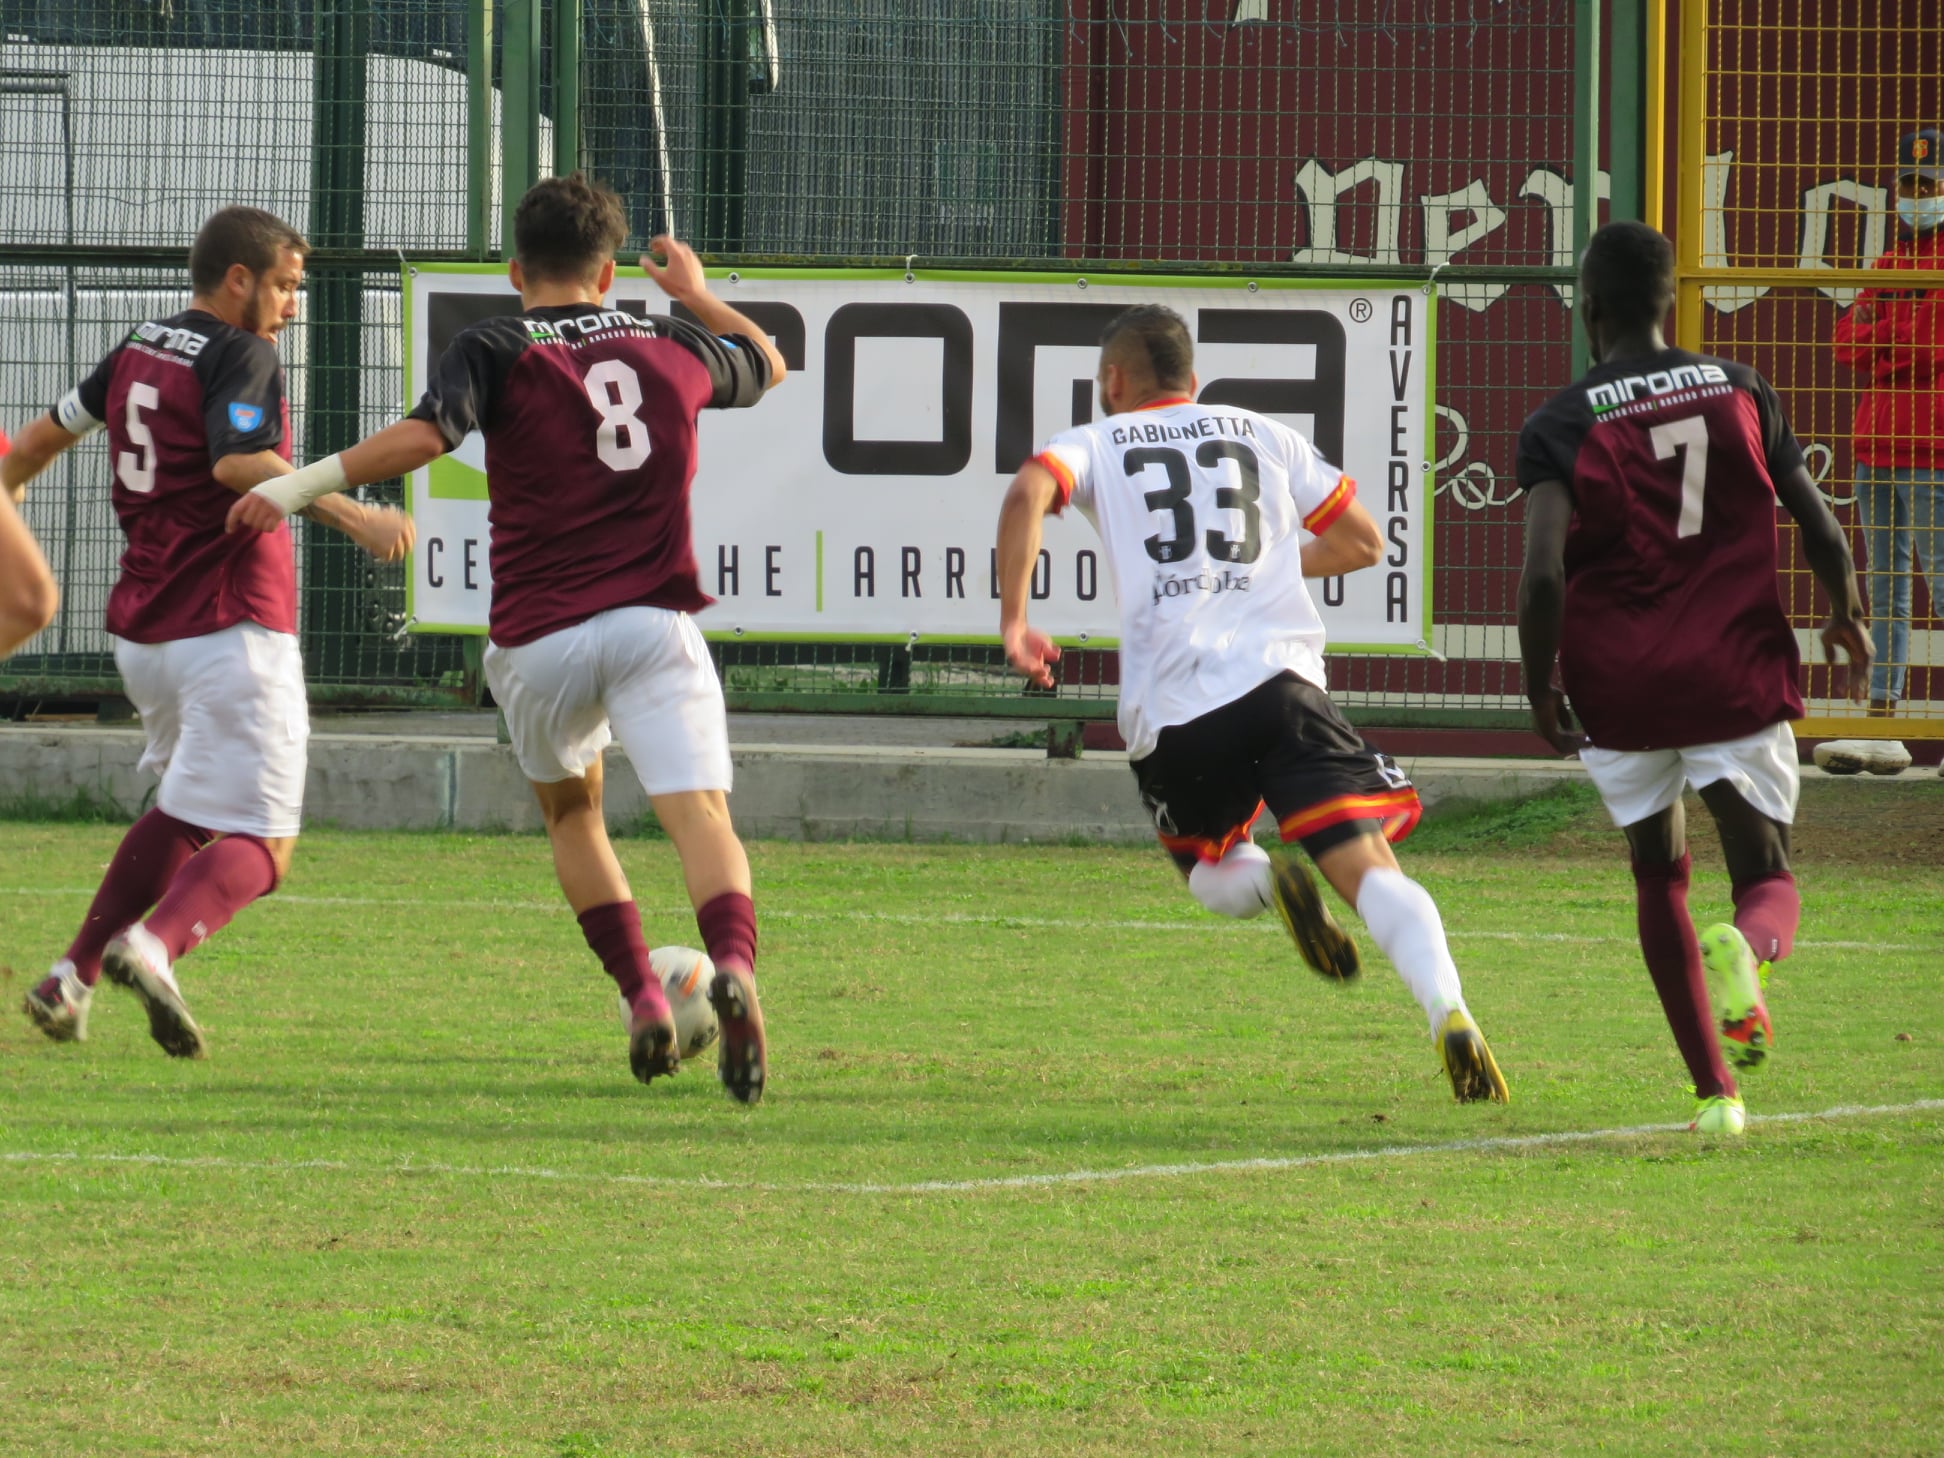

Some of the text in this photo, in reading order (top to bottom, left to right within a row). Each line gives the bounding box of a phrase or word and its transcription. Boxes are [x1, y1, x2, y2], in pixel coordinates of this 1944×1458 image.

[523, 311, 654, 341] mrom
[116, 381, 159, 493] 5
[583, 359, 652, 472] 8
[1112, 416, 1256, 445] GABIONETTA
[1586, 364, 1729, 406] miroma
[1123, 440, 1262, 564] 33
[1387, 295, 1413, 623] AVERSA
[1649, 415, 1709, 539] 7
[854, 545, 1097, 601] ARRDO
